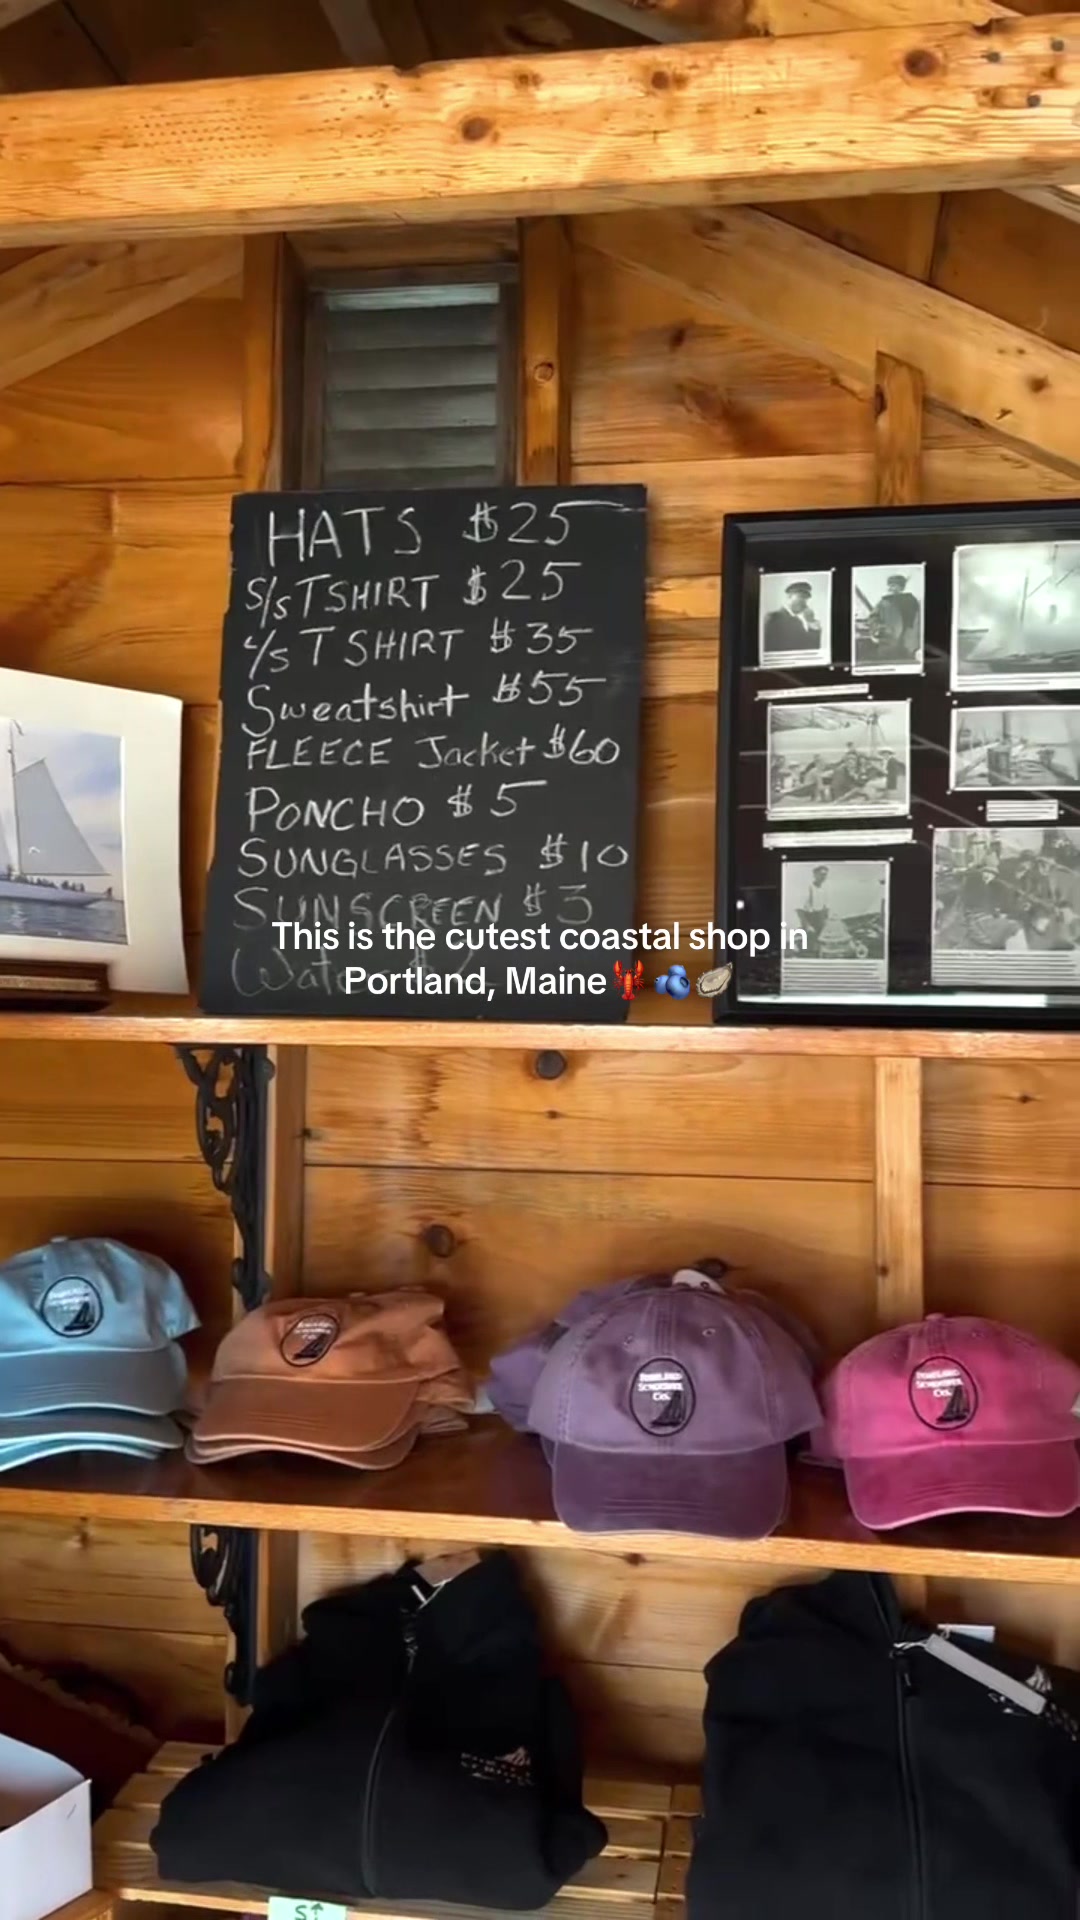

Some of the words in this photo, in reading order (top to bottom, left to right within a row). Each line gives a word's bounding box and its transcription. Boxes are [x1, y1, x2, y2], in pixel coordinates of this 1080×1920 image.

[269, 507, 422, 567] HATS
[462, 500, 625, 546] $25
[241, 682, 470, 738] Sweatshirt
[492, 669, 607, 707] $55
[246, 735, 394, 771] FLEECE
[415, 731, 537, 770] Jacket
[543, 722, 621, 766] $60
[245, 785, 425, 833] PONCHO
[238, 837, 508, 880] SUNGLASSES
[539, 832, 630, 873] $10
[233, 886, 504, 932] SUNSCREEN
